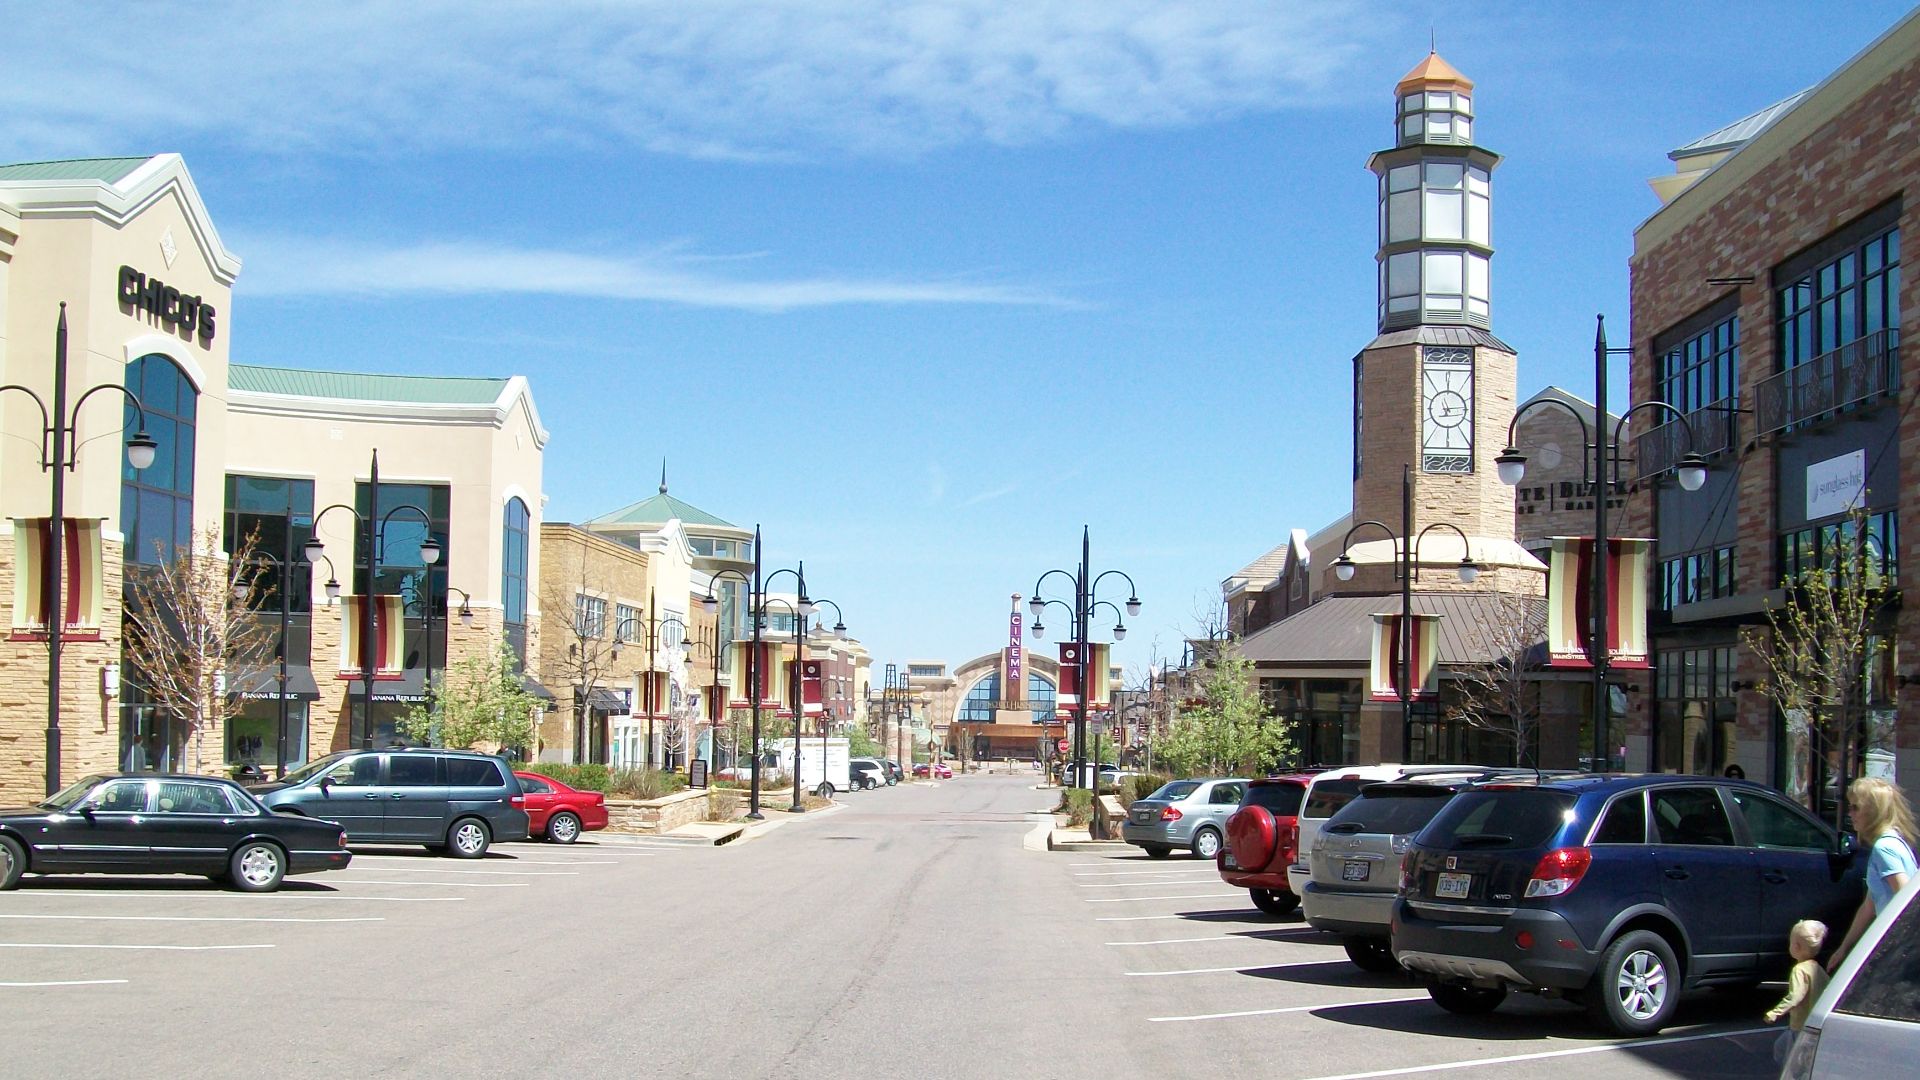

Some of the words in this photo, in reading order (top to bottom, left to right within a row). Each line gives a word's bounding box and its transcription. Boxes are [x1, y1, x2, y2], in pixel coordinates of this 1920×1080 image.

[118, 265, 216, 339] CHICO'S
[1560, 482, 1628, 498] BLAK
[1820, 472, 1849, 497] sunglass
[1565, 500, 1624, 511] MARET
[1010, 616, 1021, 678] CINEMA
